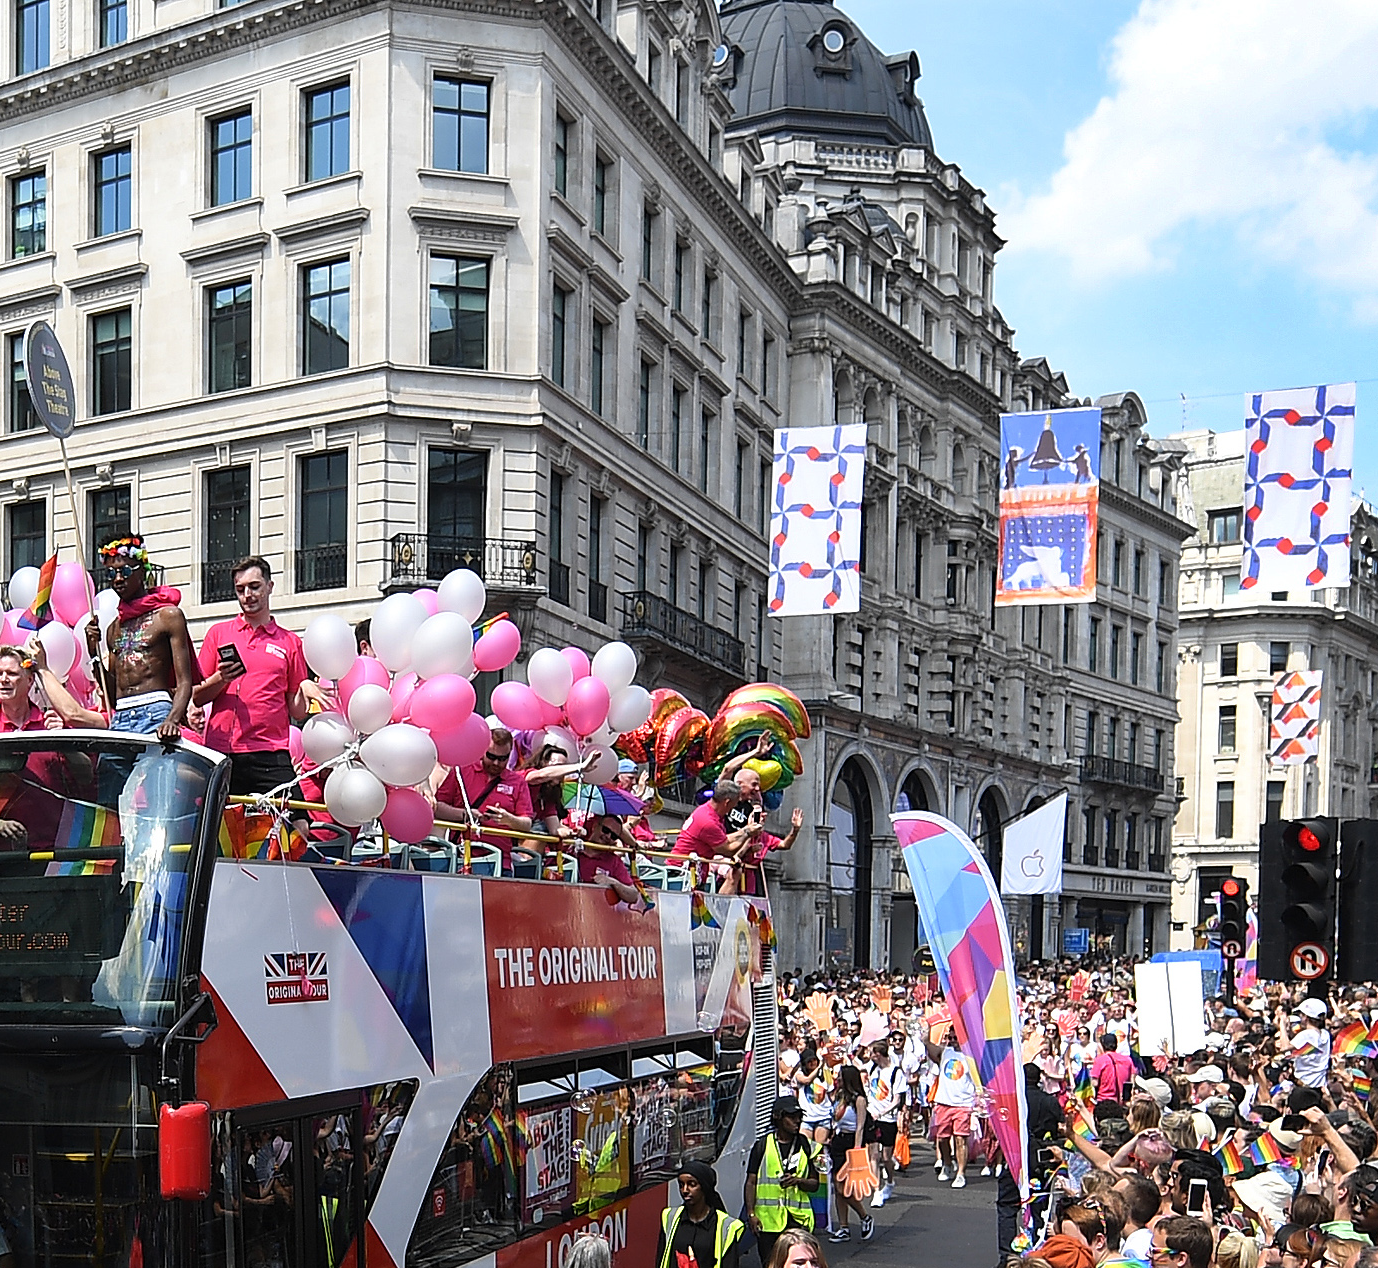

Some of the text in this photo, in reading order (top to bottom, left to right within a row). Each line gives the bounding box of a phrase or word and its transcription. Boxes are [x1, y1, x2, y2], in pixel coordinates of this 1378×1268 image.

[494, 945, 657, 988] THE ORIGINAL TOUR
[268, 985, 302, 999] ORIGINA
[543, 1131, 565, 1166] THE
